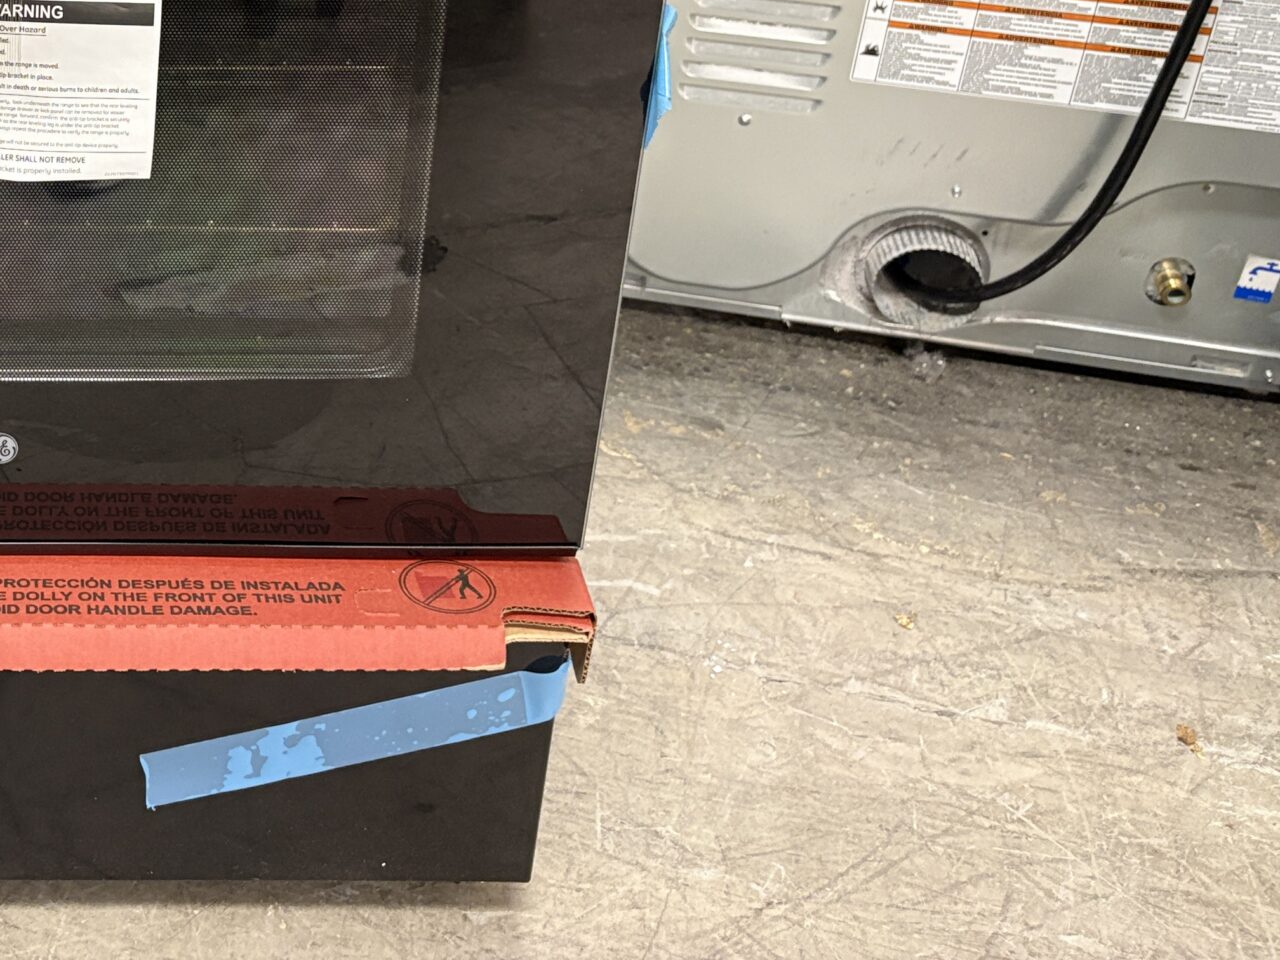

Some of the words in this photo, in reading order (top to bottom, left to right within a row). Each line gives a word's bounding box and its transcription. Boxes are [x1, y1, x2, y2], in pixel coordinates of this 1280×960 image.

[18, 26, 47, 34] Hazard
[15, 154, 37, 163] SHALL
[56, 156, 86, 164] REMOVE
[117, 577, 205, 590] DESPUÉS
[210, 580, 235, 590] DE
[240, 580, 346, 591] INSTALADA
[12, 591, 73, 601] DOLLY
[77, 591, 105, 602] ON
[110, 592, 148, 602] THE
[153, 592, 217, 602] FRONT
[222, 592, 247, 603] OF
[252, 593, 295, 603] THIS
[300, 593, 342, 604] UNIT
[25, 604, 81, 614] DOOR
[87, 604, 165, 615] HANDLE
[170, 605, 258, 616] DAMAGE.
